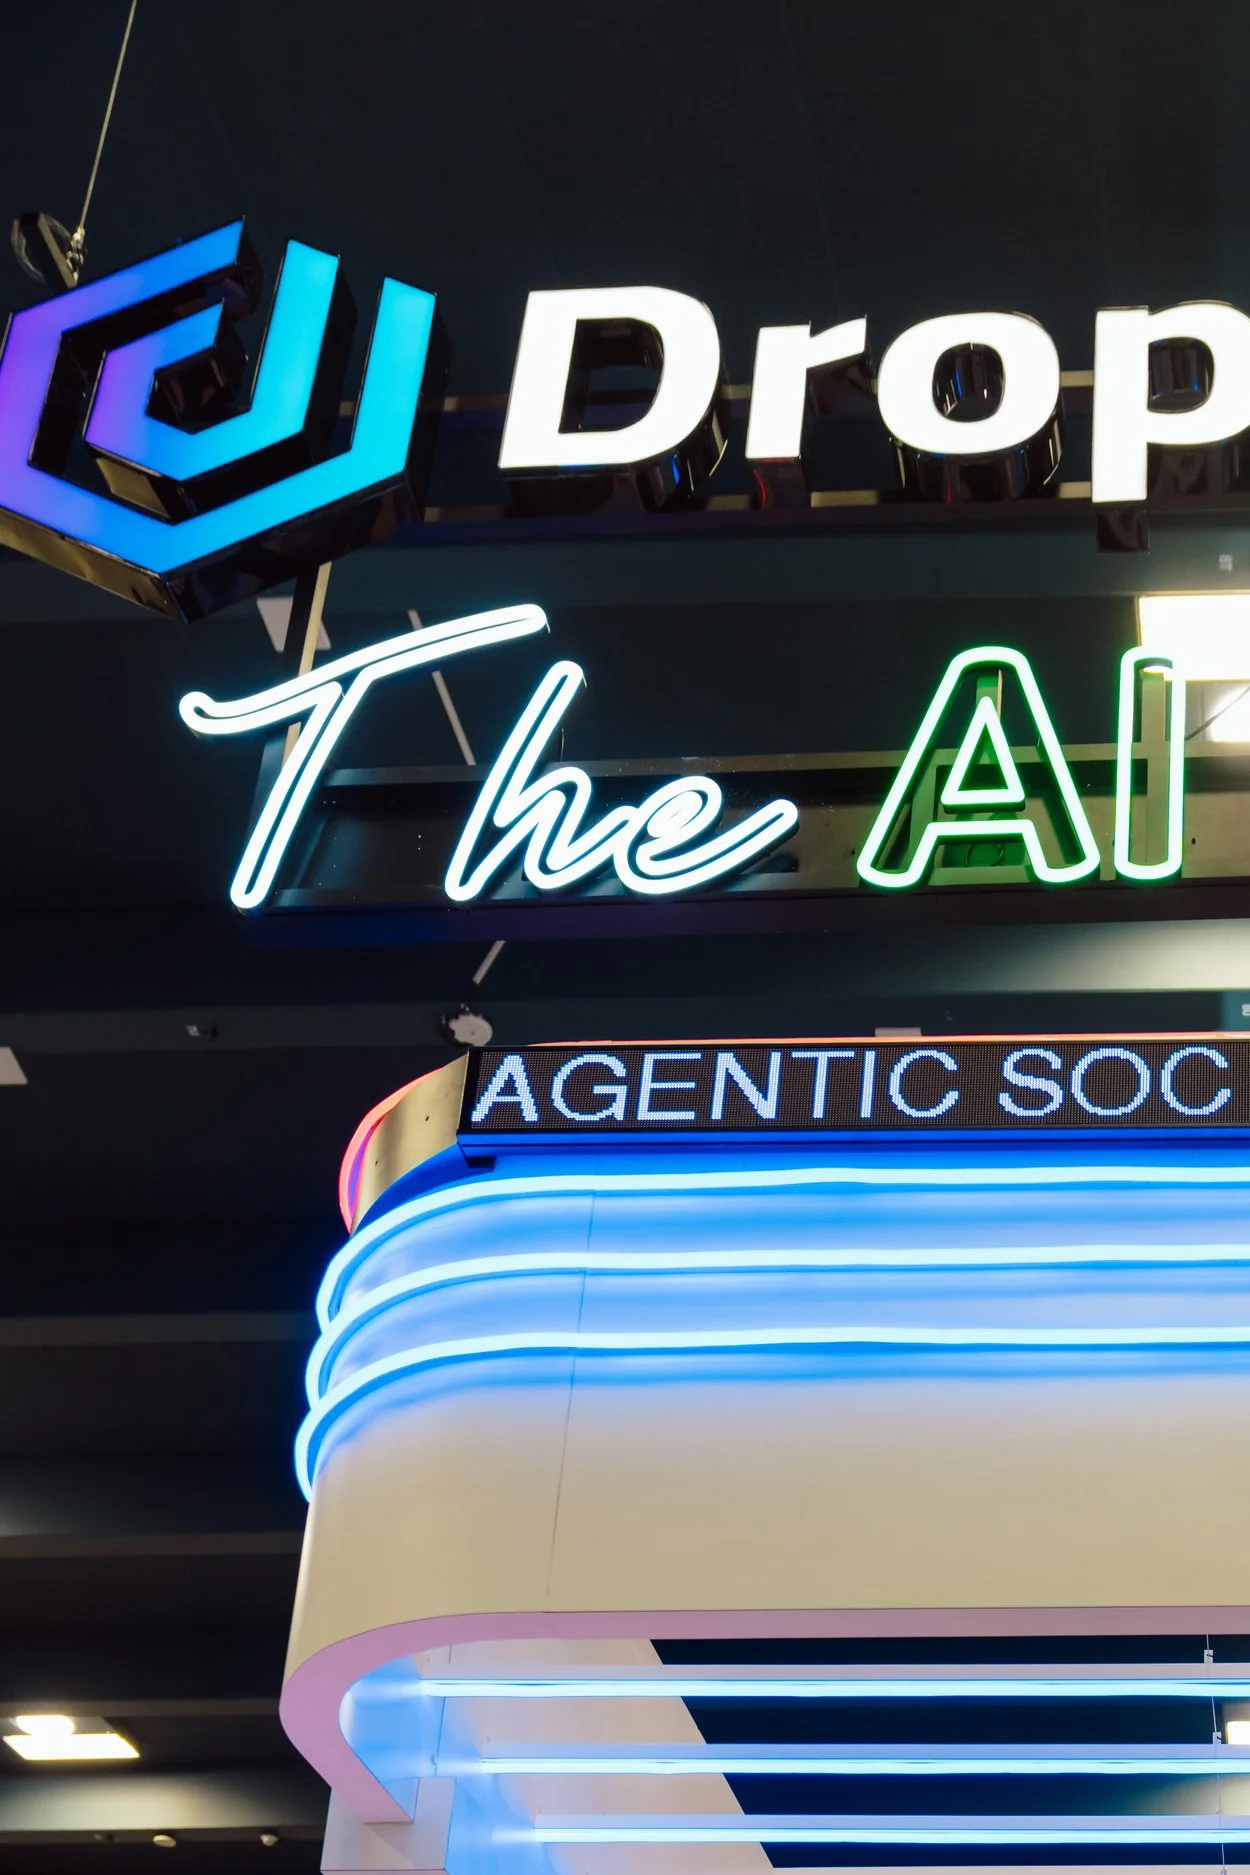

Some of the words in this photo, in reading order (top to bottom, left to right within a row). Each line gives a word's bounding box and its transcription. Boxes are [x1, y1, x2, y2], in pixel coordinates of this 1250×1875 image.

[178, 604, 798, 910] The
[857, 645, 1187, 889] AI
[471, 1048, 961, 1124] AGENTIC
[999, 1046, 1233, 1118] SOC
